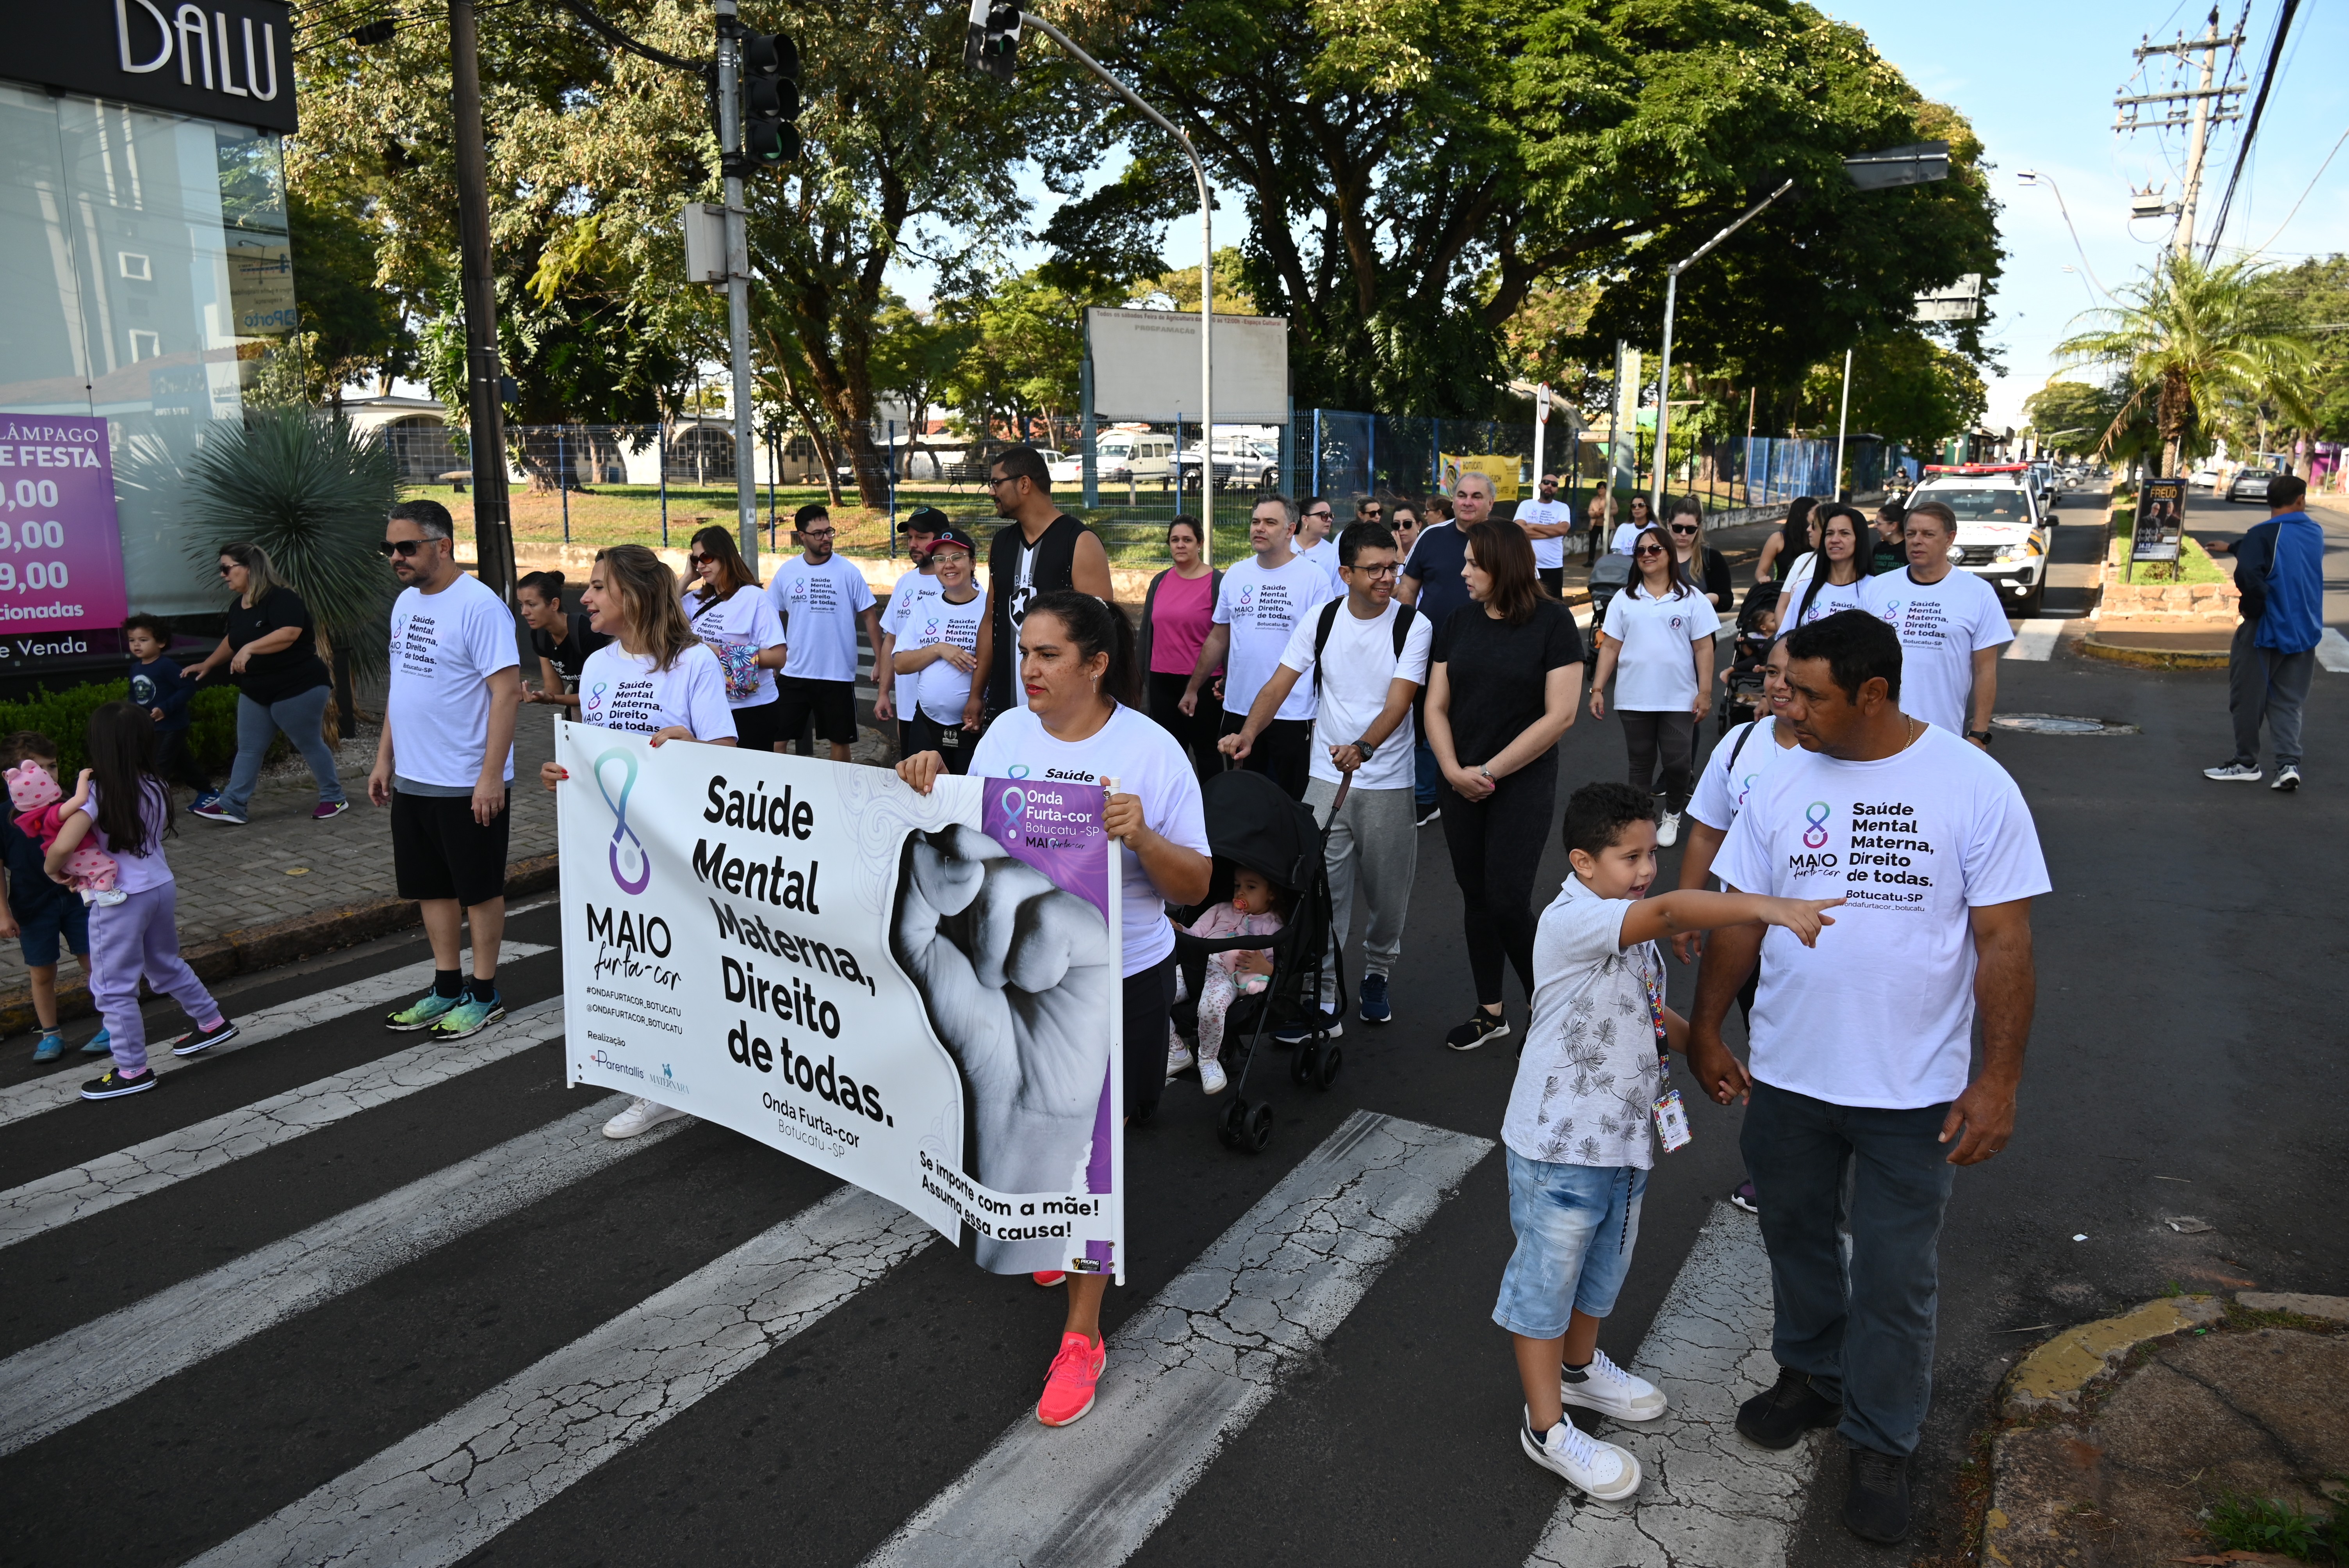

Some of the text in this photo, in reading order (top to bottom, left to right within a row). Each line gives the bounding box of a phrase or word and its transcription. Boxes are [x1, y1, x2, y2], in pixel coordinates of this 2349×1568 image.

[116, 0, 278, 102] DALU
[20, 446, 102, 468] FESTA
[1463, 461, 1483, 470] BOTUCATU
[2150, 488, 2177, 498] FREUD
[1259, 598, 1293, 607] Materna,
[412, 615, 435, 625] Saúde
[1907, 615, 1948, 623] Materna,
[409, 624, 434, 634] Mental
[697, 627, 715, 636] Direito
[1919, 630, 1947, 638] todas.
[17, 636, 87, 656] Venda
[406, 642, 426, 652] Direito
[407, 633, 438, 647] Materna,
[413, 654, 437, 665] todas.
[618, 681, 652, 689] Saúde
[611, 700, 663, 712] Materna,
[610, 710, 648, 720] Direito
[609, 721, 623, 729] de
[1045, 768, 1094, 782] Saúde
[1027, 789, 1062, 805] Onda
[703, 775, 813, 840] Saúde
[1027, 806, 1092, 823] Furta-cor
[1852, 802, 1914, 816] Saúde
[1026, 822, 1076, 836] Botucatu
[1852, 819, 1918, 834] Mental
[1851, 836, 1934, 855] Materna,
[1789, 853, 1837, 868] MAIO
[1849, 852, 1911, 867] Direito
[693, 838, 820, 914] Mental
[1847, 869, 1933, 887] de todas.
[1846, 890, 1923, 902] Botucatu-SP
[586, 903, 671, 958] MAIO
[708, 896, 875, 996] Materna,
[594, 941, 681, 991] furta-cor
[586, 986, 681, 1017] #ONDAFURTACOR_BOTUCATU
[722, 955, 840, 1039] Direito
[586, 1004, 683, 1035] @ONDAFURTACOR_BOTUCATU
[588, 1031, 626, 1046] Realização
[728, 1019, 893, 1128] de todas.
[763, 1092, 859, 1147] Onda Furta-cor
[779, 1119, 824, 1151] Botucatu
[920, 1151, 1098, 1216] Se importe com a mãe!
[922, 1174, 1071, 1240] Assuma essa causa!
